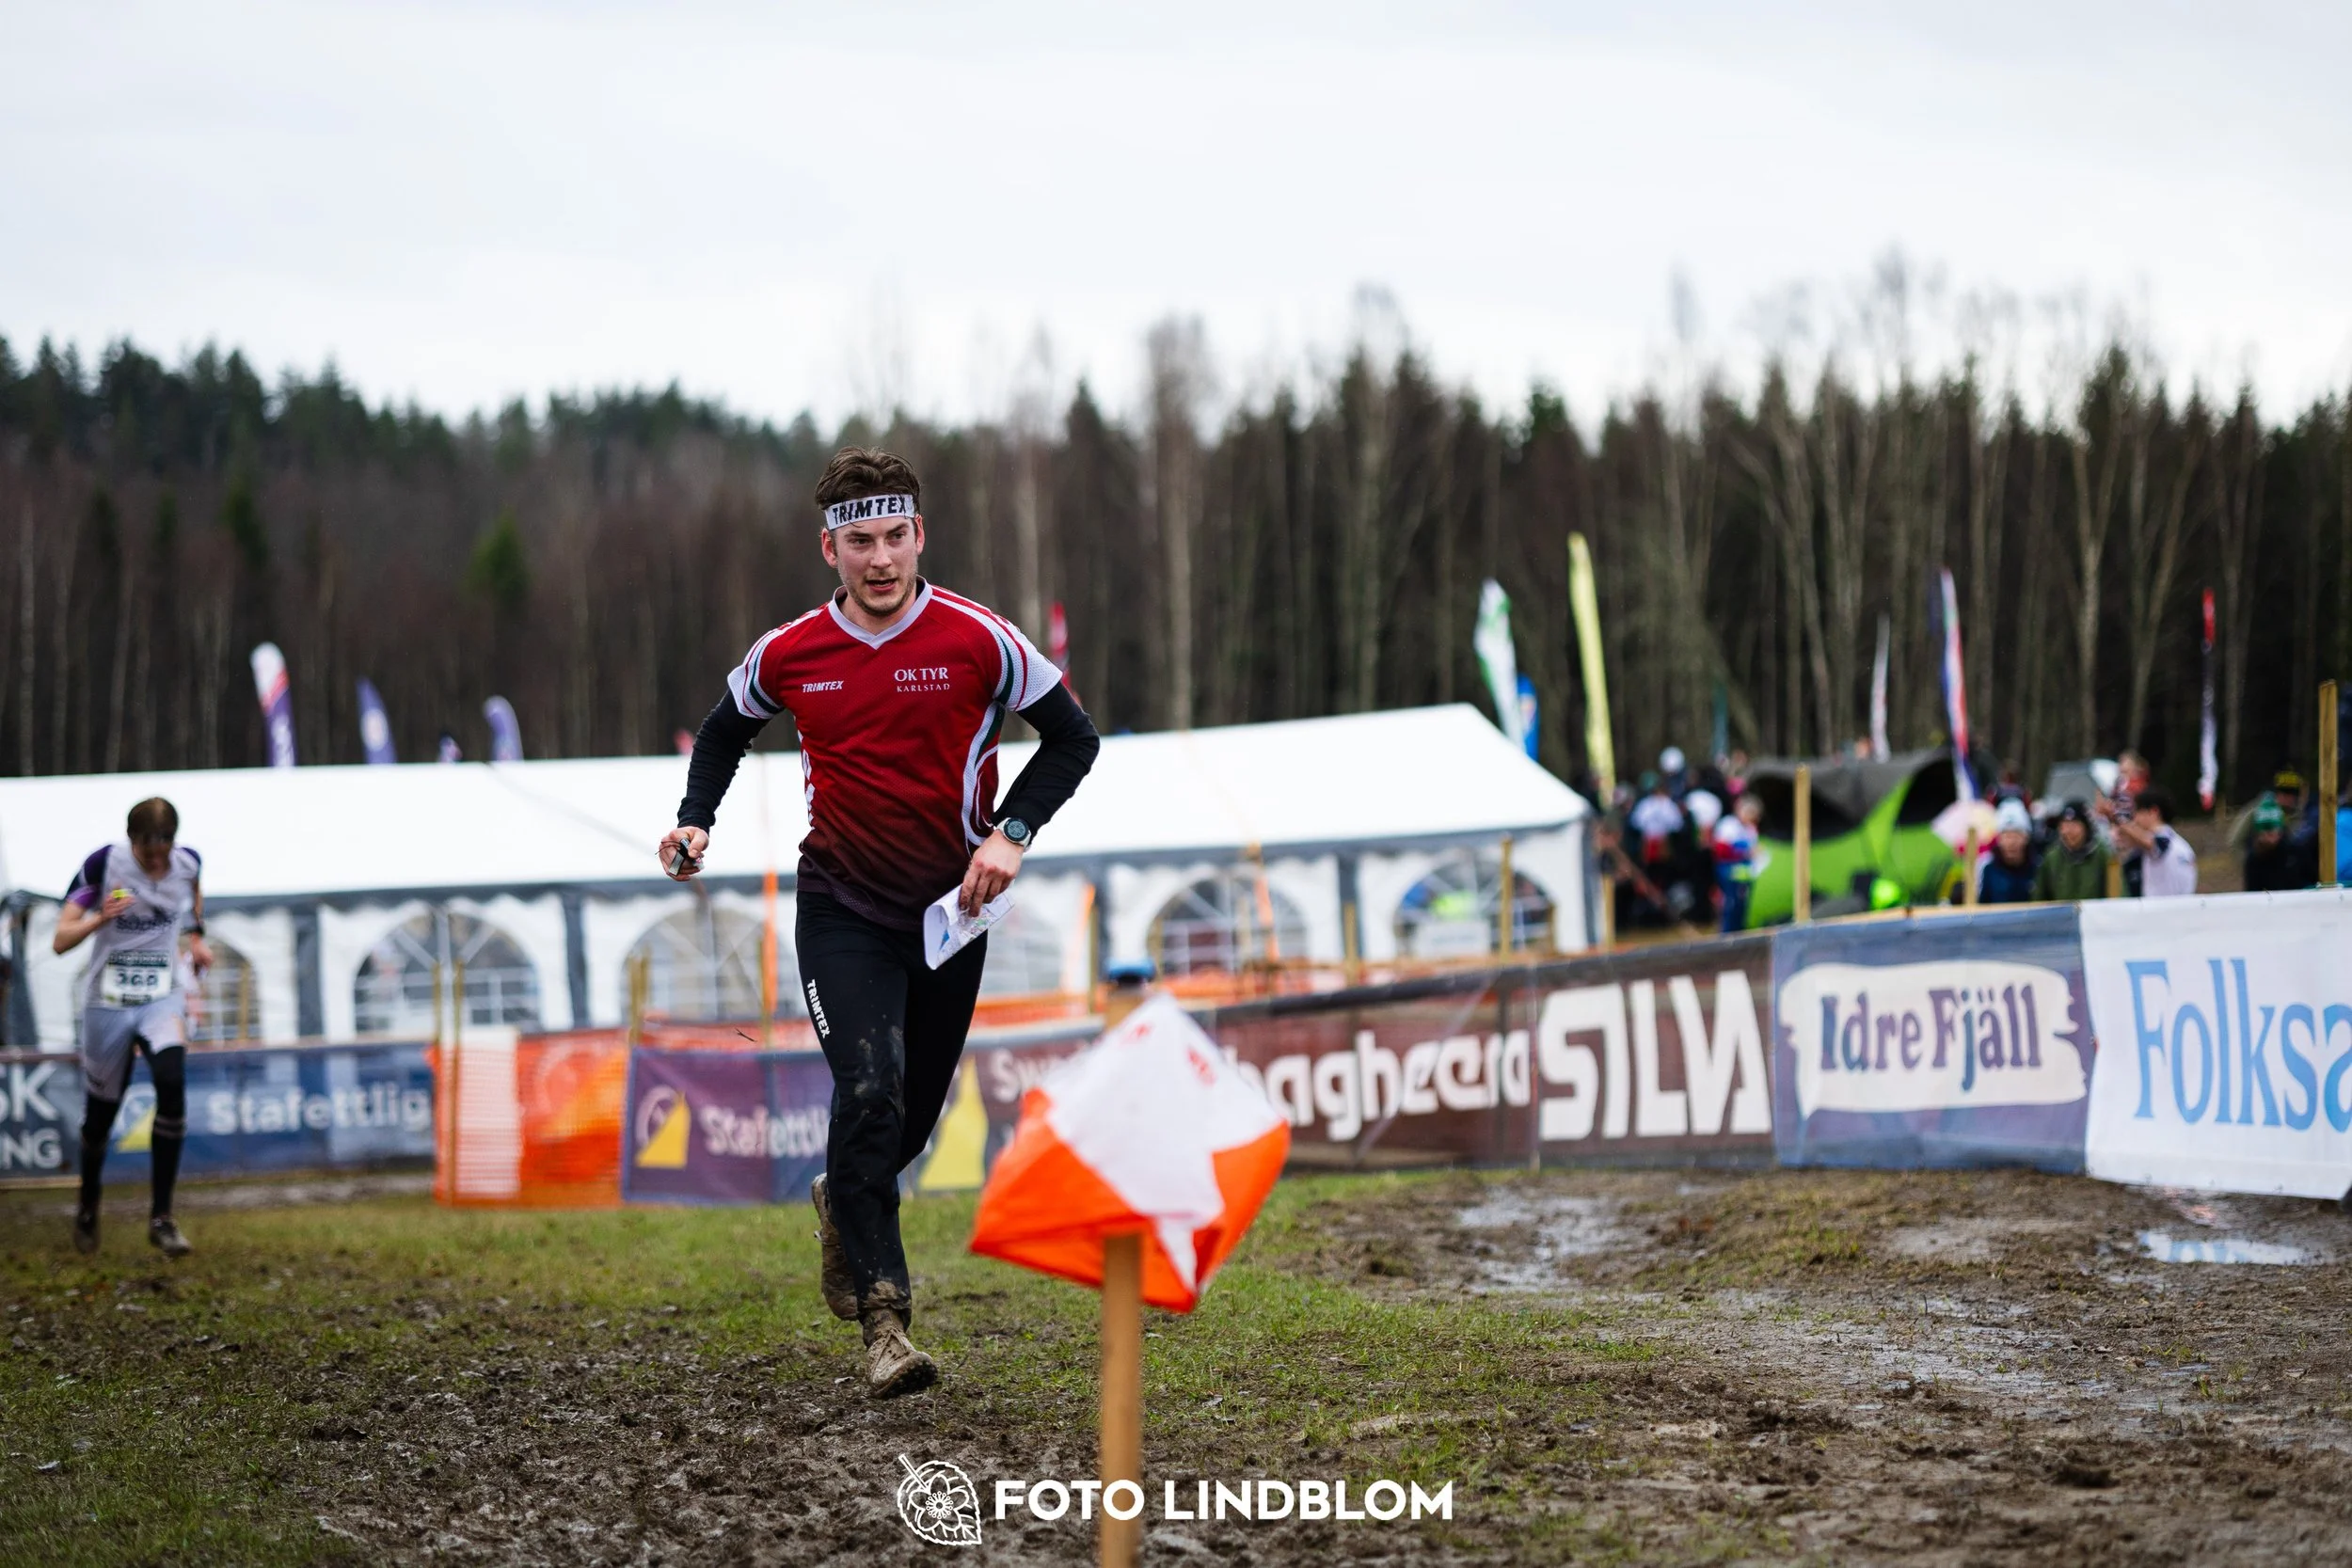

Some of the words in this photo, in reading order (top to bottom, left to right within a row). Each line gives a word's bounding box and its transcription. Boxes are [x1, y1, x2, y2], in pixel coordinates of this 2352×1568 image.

[833, 497, 906, 525] TRIMTEX
[803, 680, 844, 692] TRIMTEX
[895, 669, 916, 682] OK
[920, 667, 948, 680] TYR
[897, 683, 950, 692] KARLSTAD
[807, 979, 831, 1038] TRIMTEX
[1538, 968, 1772, 1141] SILVA
[1820, 990, 1924, 1071] Idre
[1928, 982, 2042, 1092] Fjäll
[2123, 956, 2352, 1133] Folksa
